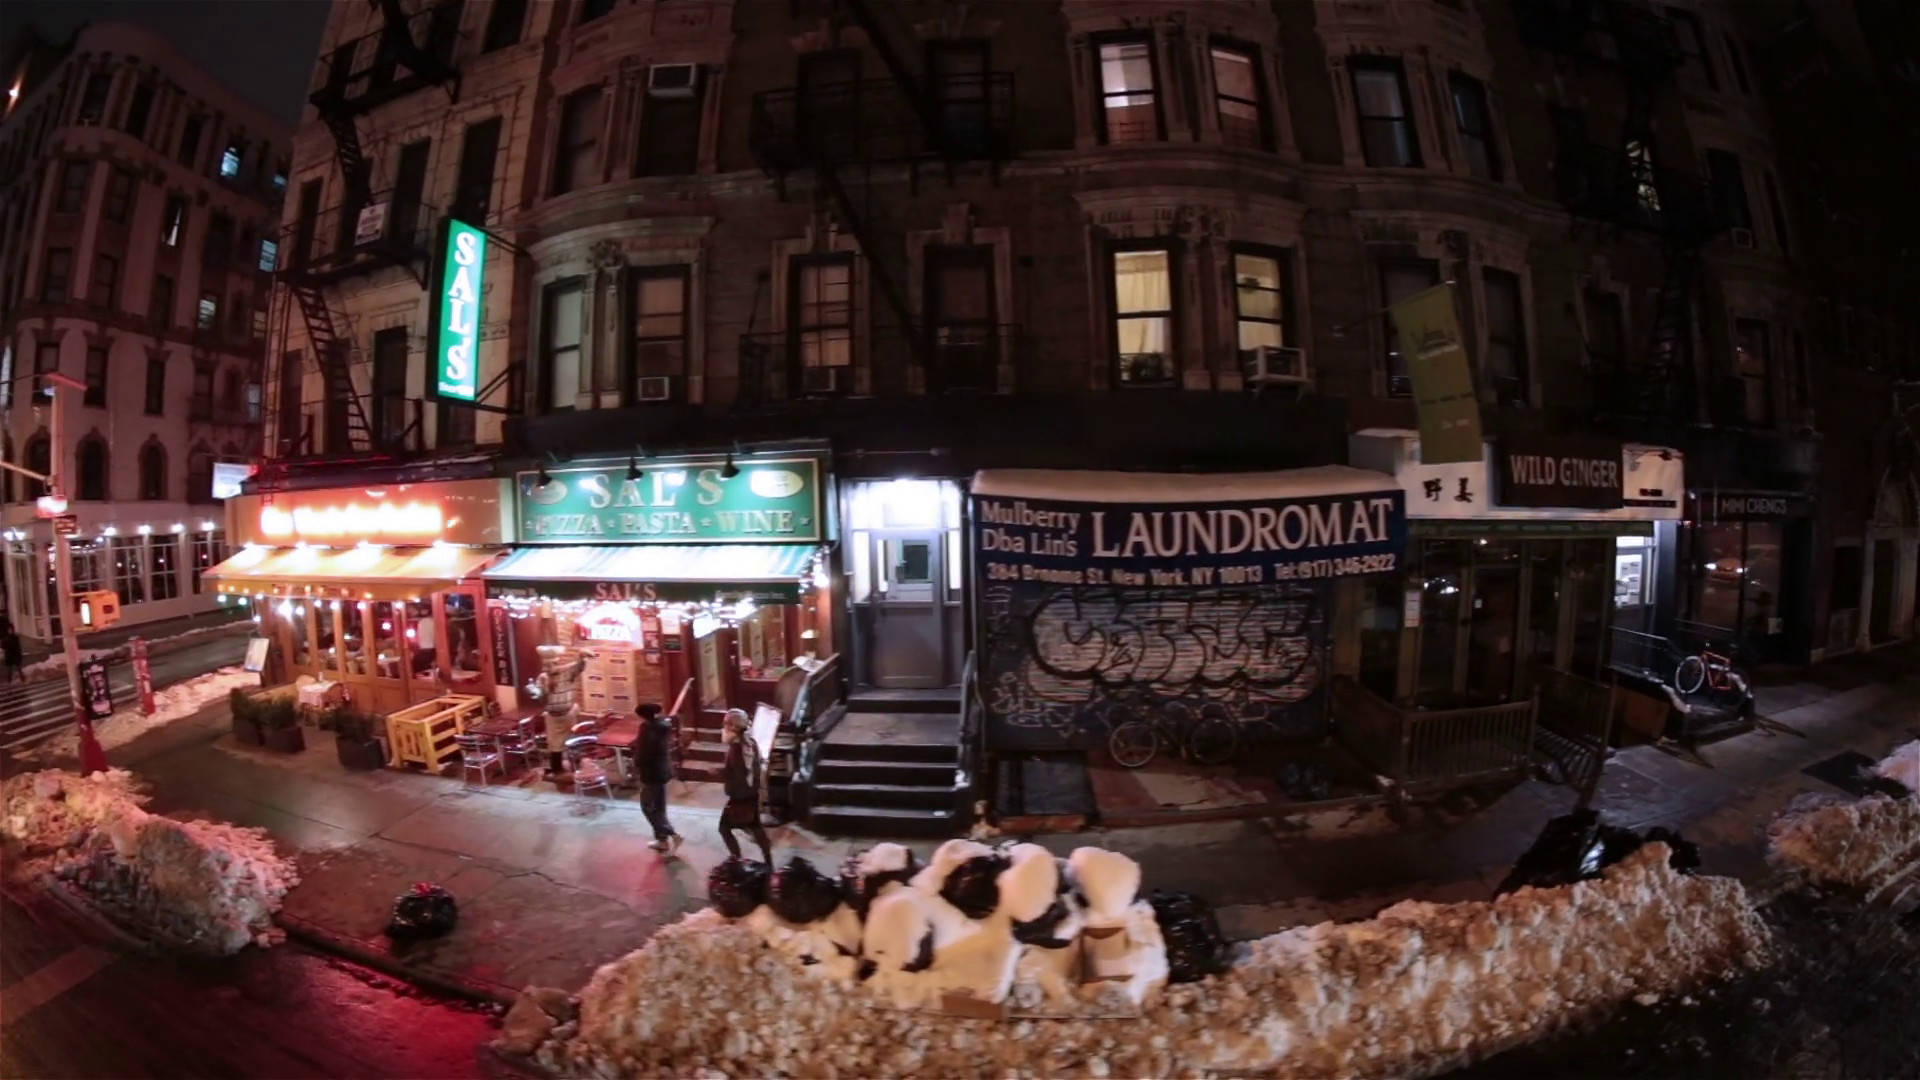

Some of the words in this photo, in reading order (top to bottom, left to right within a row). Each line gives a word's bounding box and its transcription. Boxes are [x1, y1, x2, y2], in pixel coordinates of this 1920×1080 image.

[1510, 454, 1556, 486] WILD
[1560, 457, 1618, 488] GINGER
[589, 468, 725, 508] SAL'S
[535, 513, 605, 537] PIZZA
[620, 512, 696, 534] PASTA
[715, 510, 794, 533] WINE
[980, 500, 1081, 534] Mulberry
[1091, 498, 1394, 558] LAUNDROMAT
[982, 528, 1026, 553] Dba
[1031, 532, 1078, 557] Lin's
[595, 582, 658, 601] SAL'S
[1112, 568, 1146, 585] New
[1192, 567, 1215, 585] NY
